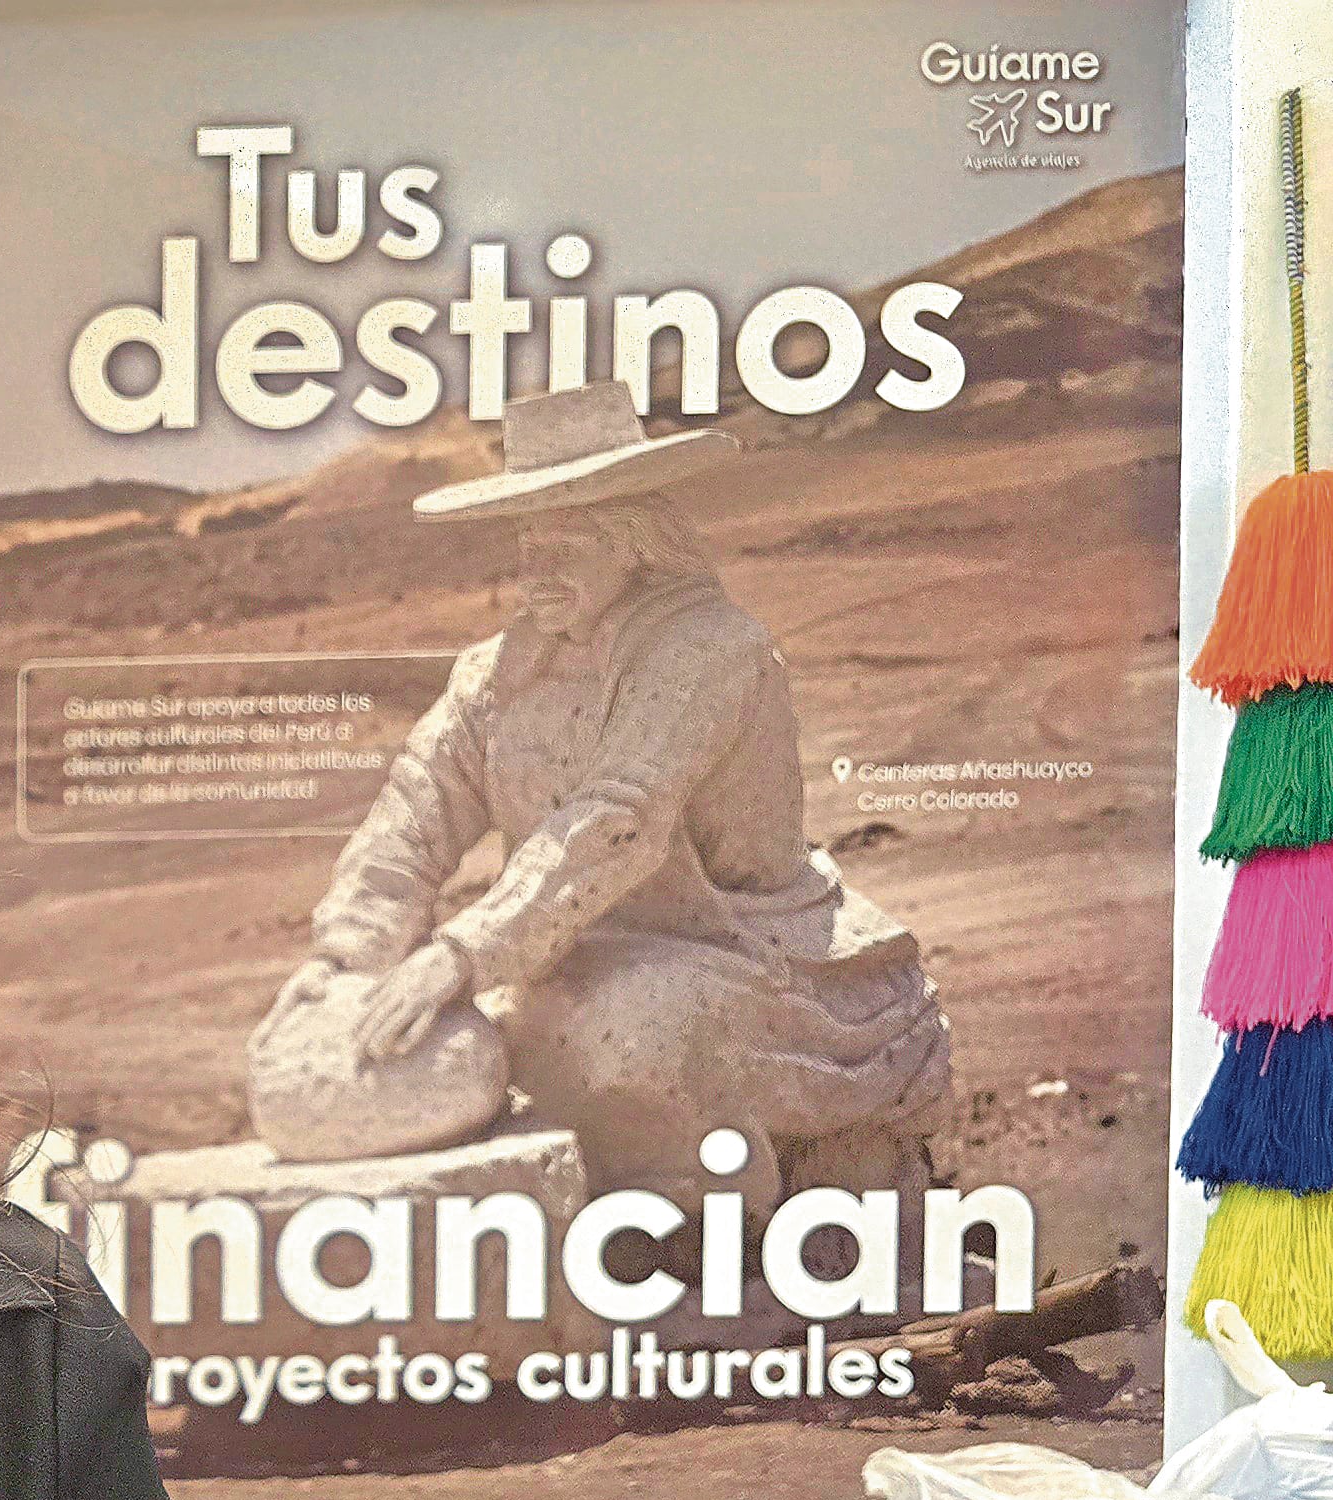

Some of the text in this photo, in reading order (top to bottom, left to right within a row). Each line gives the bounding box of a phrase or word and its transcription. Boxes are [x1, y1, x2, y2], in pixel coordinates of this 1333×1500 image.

[921, 42, 1100, 83] Guíame
[1036, 90, 1111, 134] Sur
[963, 153, 1081, 170] Agencia de viajes
[195, 124, 445, 266] Tus
[68, 232, 967, 435] destinos
[150, 694, 184, 717] Sur
[187, 694, 255, 721] apoya
[278, 691, 337, 714] todos
[341, 691, 373, 713] los
[285, 719, 332, 742] Perú
[857, 762, 957, 783] Canteras
[857, 788, 1020, 812] Cerro Colorado
[5, 1126, 1037, 1325] financian
[151, 1325, 914, 1423] royectos culturales
